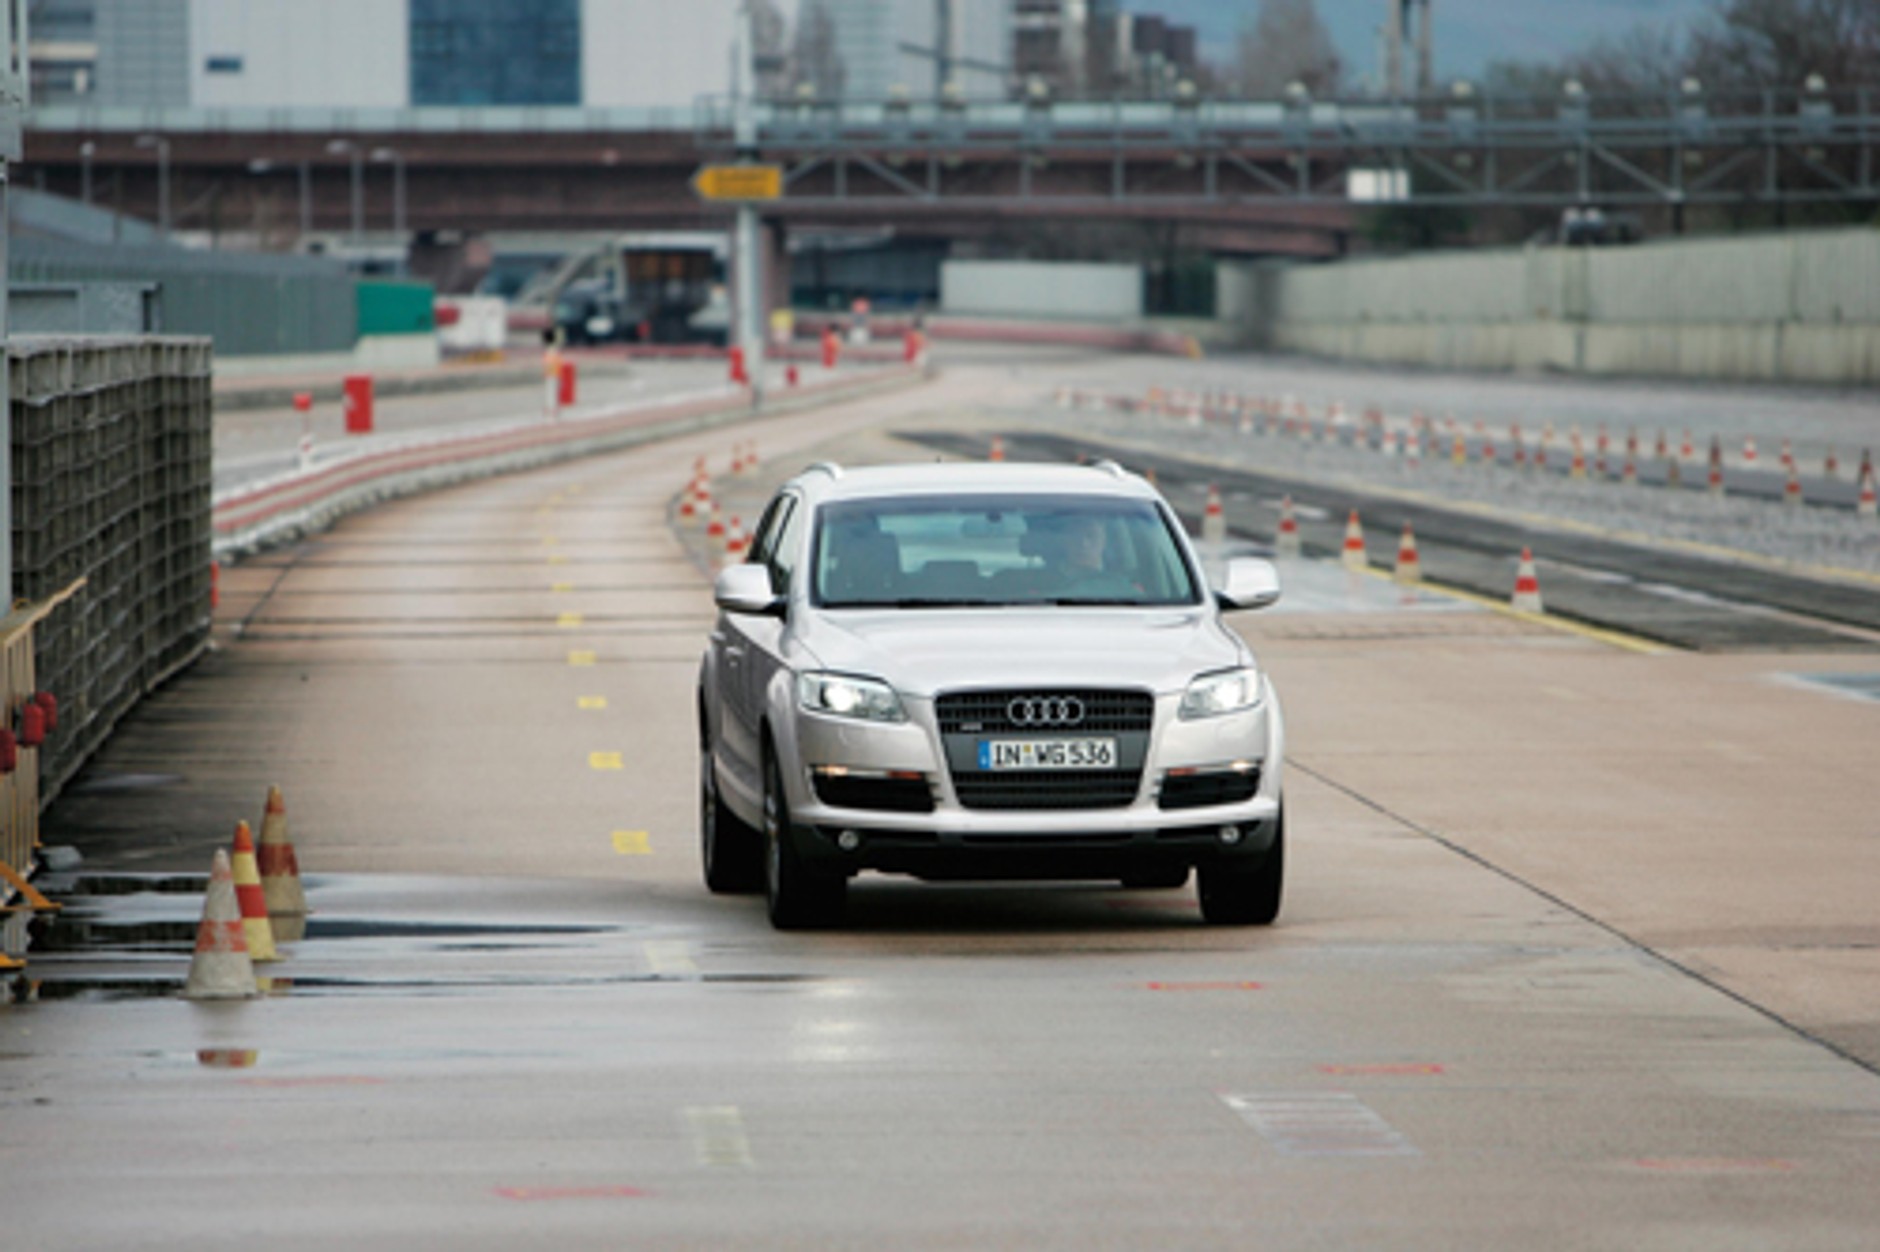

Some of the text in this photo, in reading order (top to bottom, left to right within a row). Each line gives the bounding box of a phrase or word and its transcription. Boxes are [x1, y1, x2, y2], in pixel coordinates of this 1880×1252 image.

[995, 741, 1110, 764] IN WG 536
